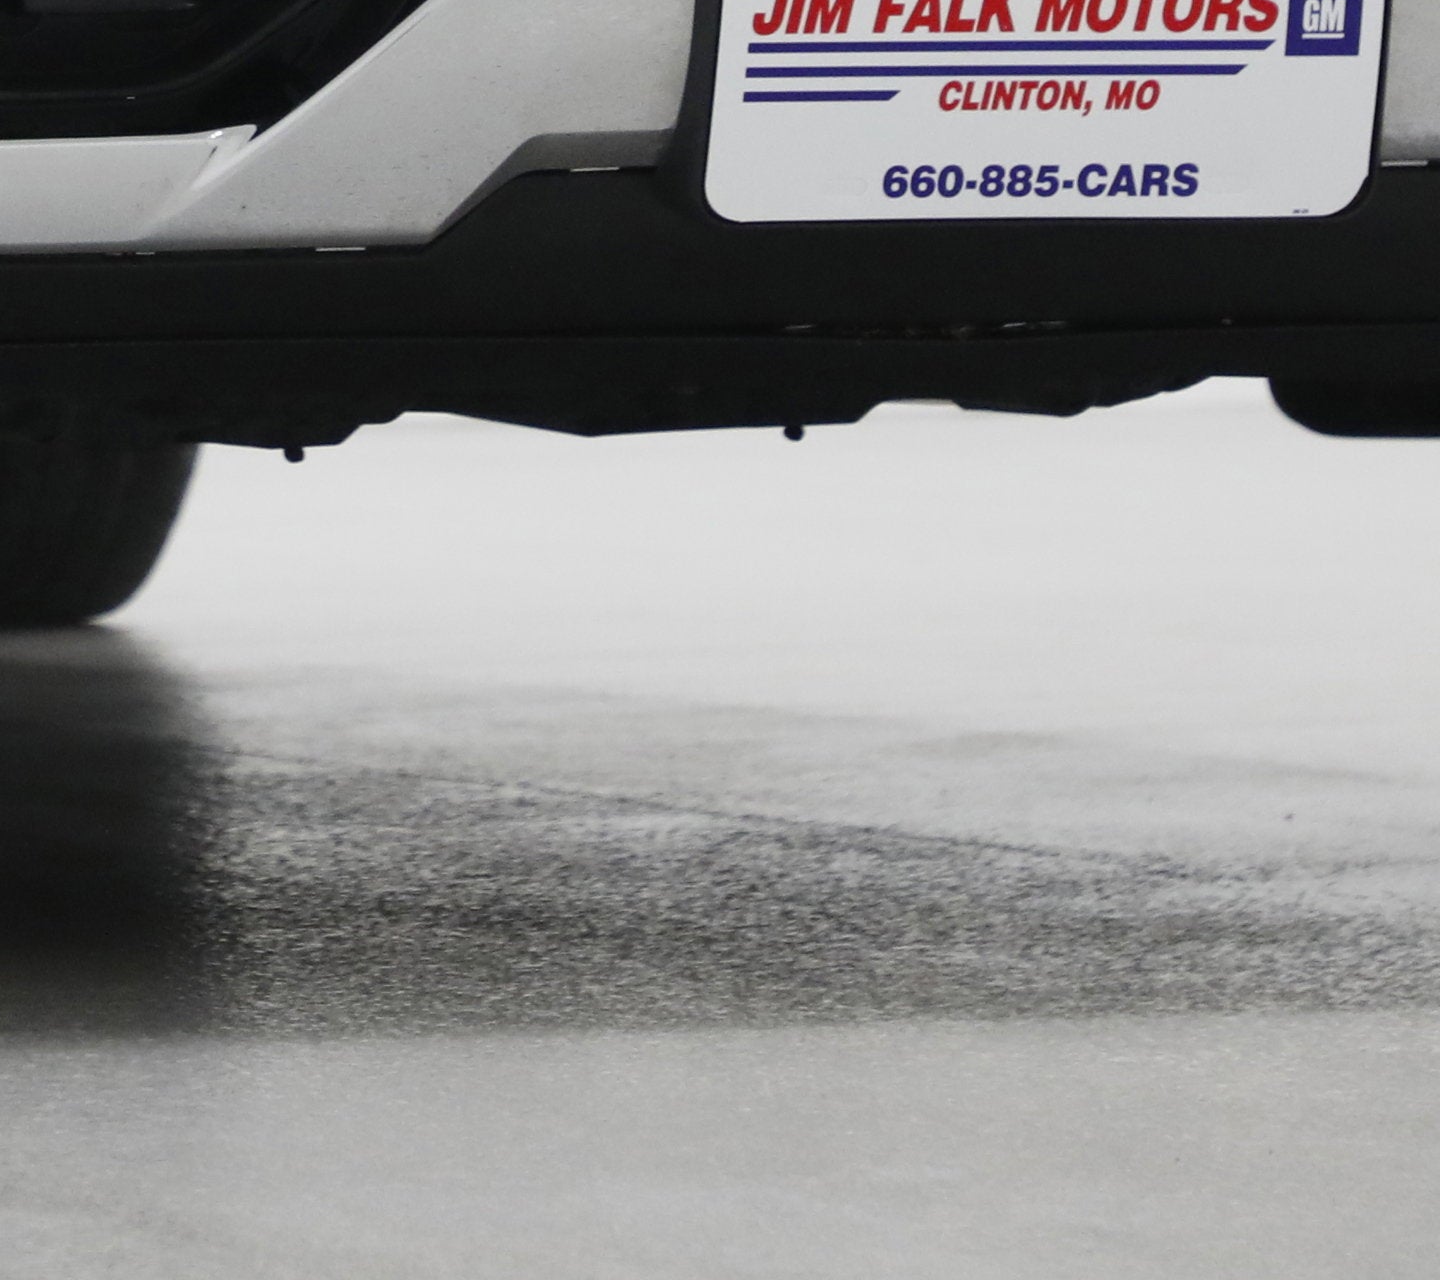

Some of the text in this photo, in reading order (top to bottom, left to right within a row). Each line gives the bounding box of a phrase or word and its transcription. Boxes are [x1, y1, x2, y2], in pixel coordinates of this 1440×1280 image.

[938, 79, 1162, 116] CLINTON, MO
[882, 163, 1200, 199] 660-885-CARS
